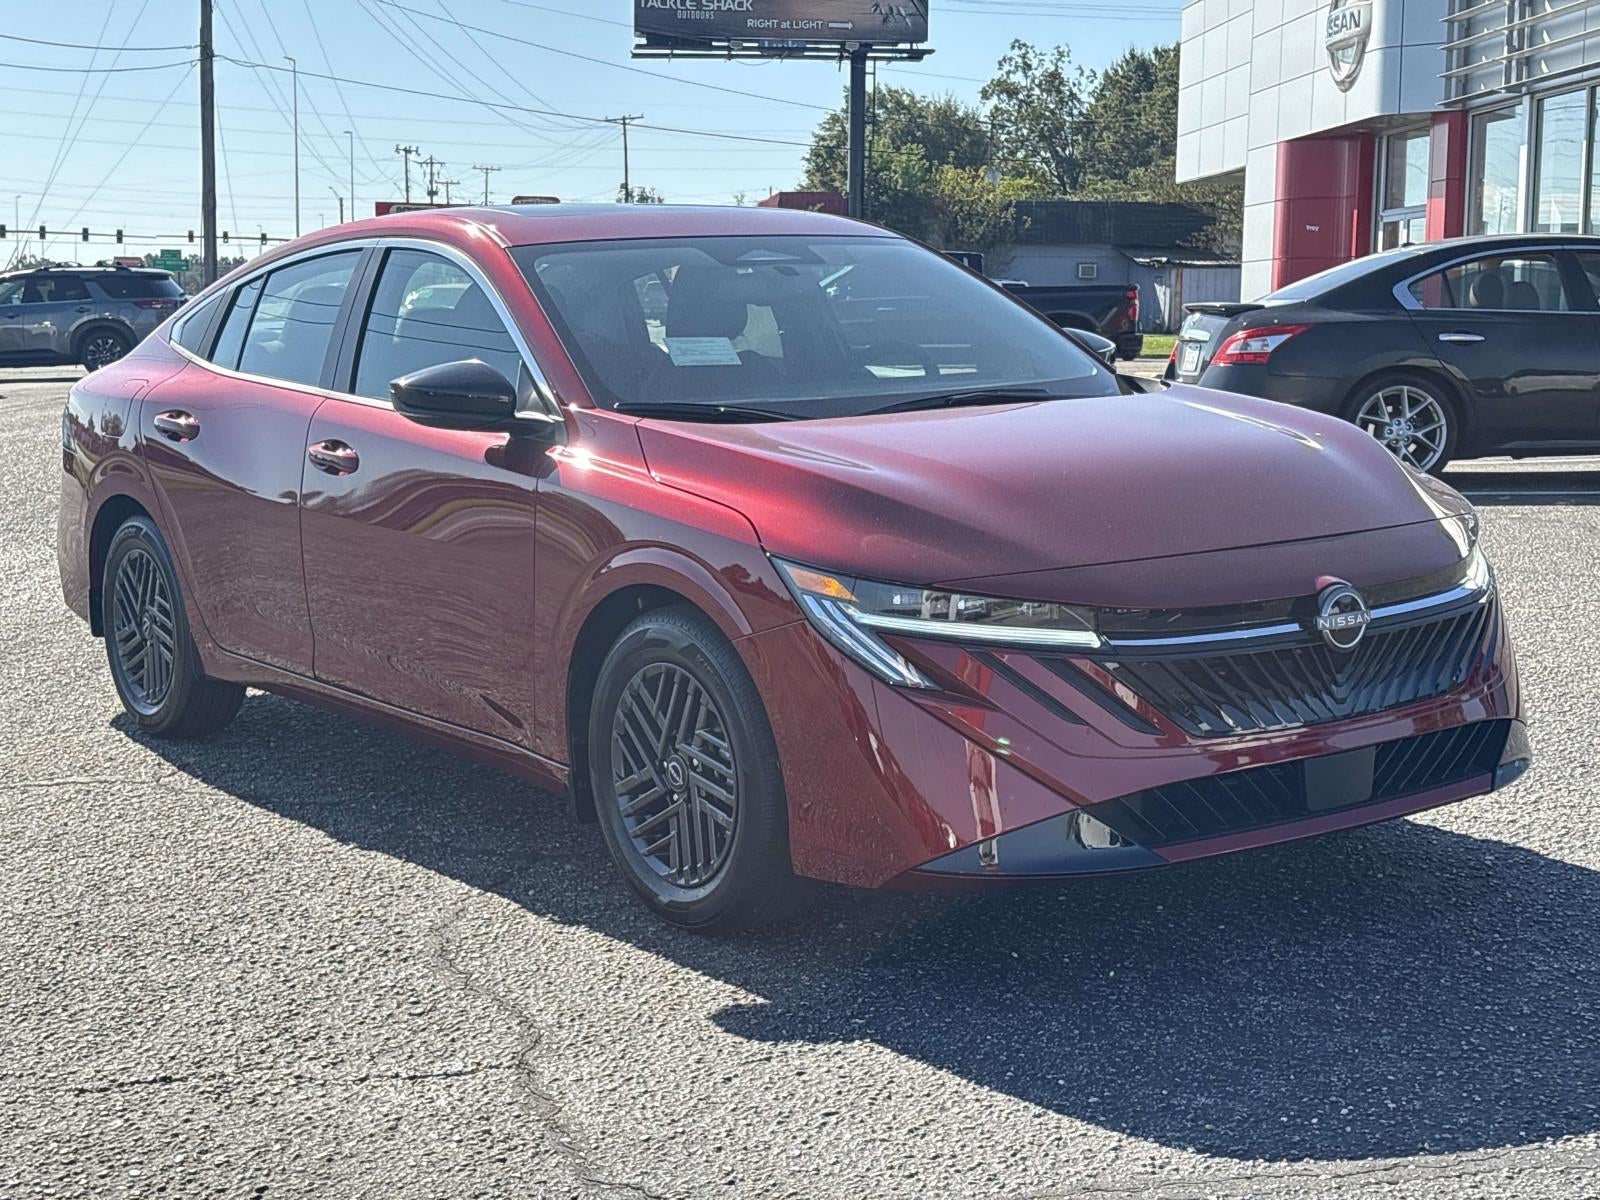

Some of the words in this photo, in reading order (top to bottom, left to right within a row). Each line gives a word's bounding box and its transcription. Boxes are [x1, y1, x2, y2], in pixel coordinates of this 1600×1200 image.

[640, 0, 697, 9] TACKLE
[702, 0, 753, 11] SHACK
[677, 10, 715, 19] OUTDOORS
[747, 19, 778, 28] RIGHT
[780, 21, 791, 29] at
[793, 20, 823, 30] LIGHT
[1319, 613, 1370, 628] NISSAN
